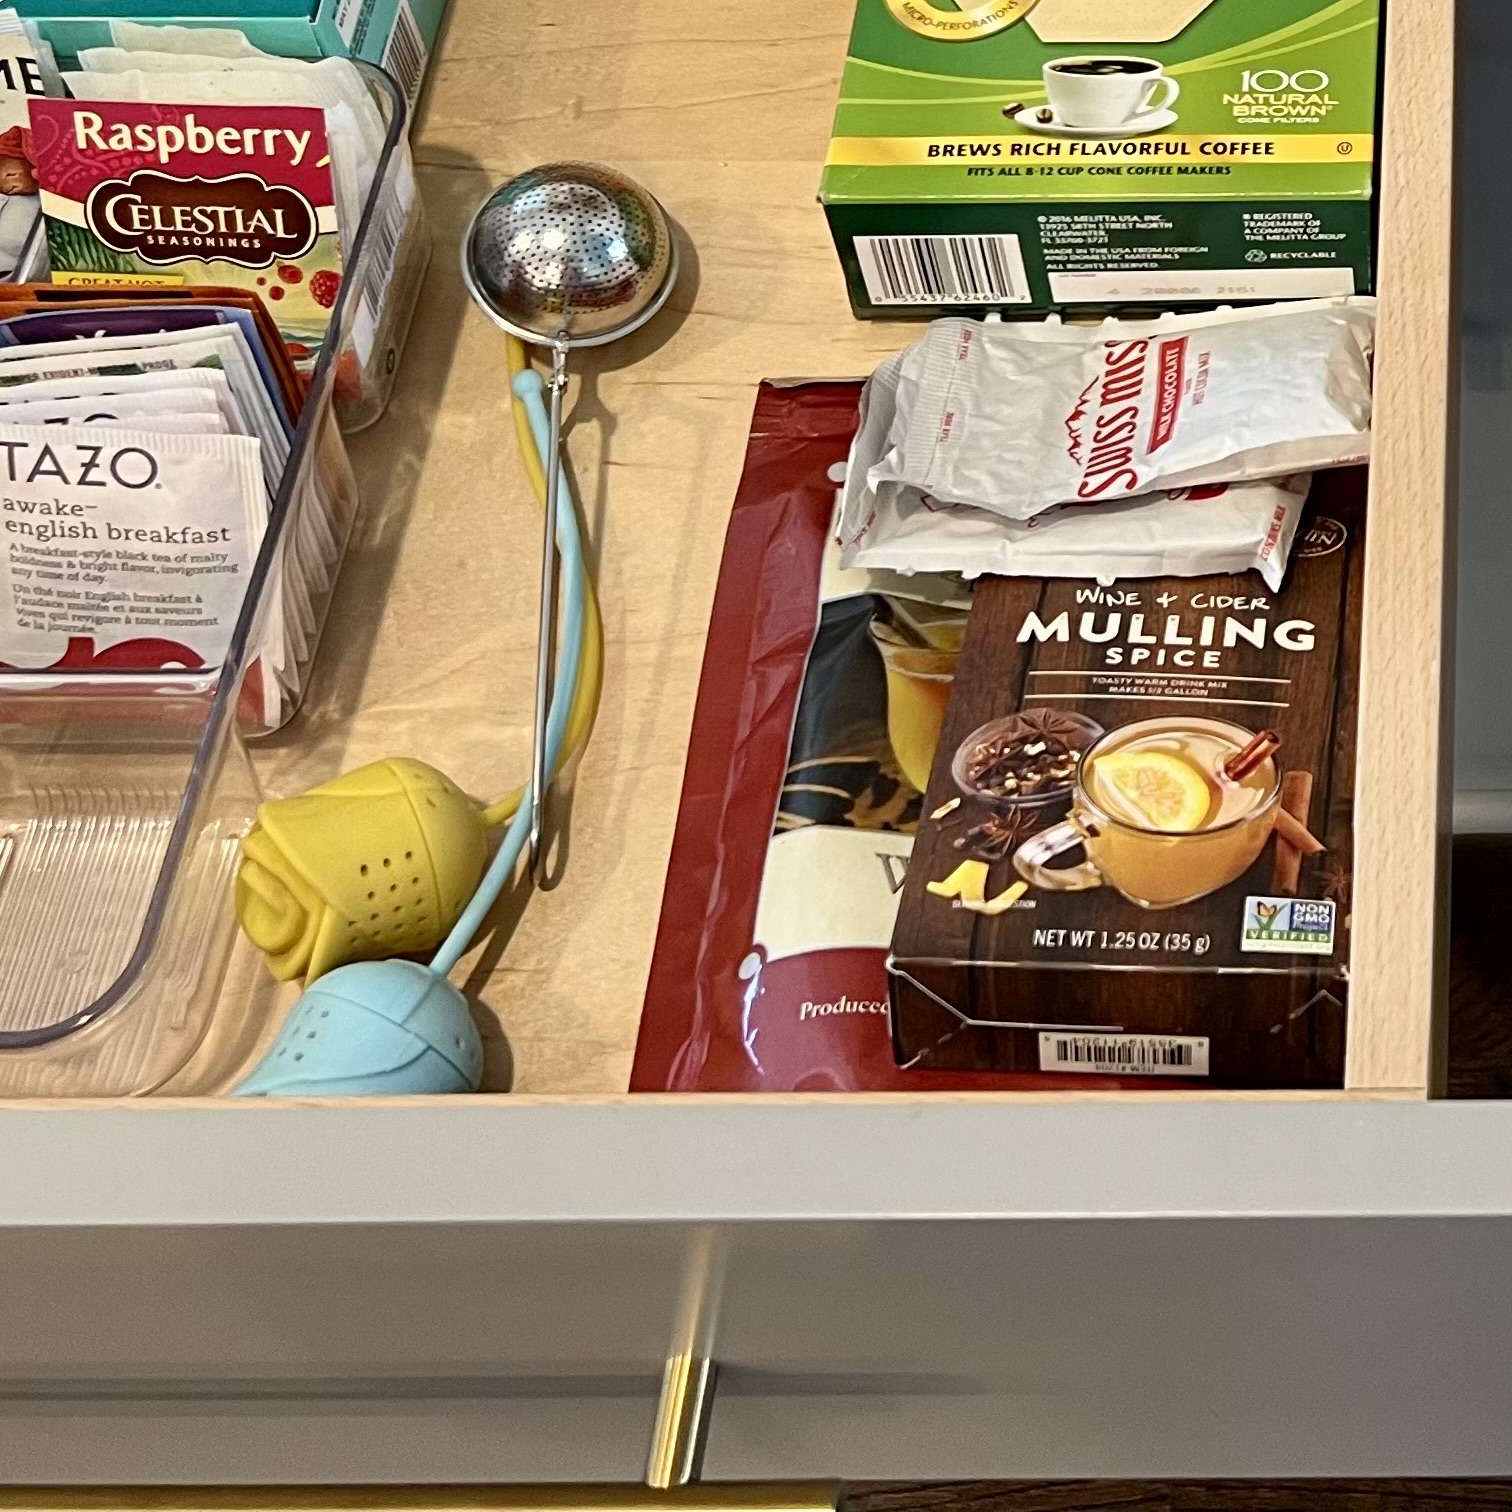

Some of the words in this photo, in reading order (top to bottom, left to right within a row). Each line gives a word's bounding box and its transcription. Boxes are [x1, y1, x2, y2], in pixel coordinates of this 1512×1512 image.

[902, 0, 1018, 31] MICRO-PERFORATIONS
[1240, 69, 1329, 93] 100
[1223, 93, 1339, 106] NATURAL
[1232, 104, 1329, 117] BROWN
[73, 111, 311, 165] Raspberry
[927, 143, 1002, 158] BREWS
[1010, 142, 1061, 157] RICH
[1069, 141, 1191, 156] FLAVORFUL
[1199, 141, 1275, 155] COFFEE
[967, 167, 994, 177] FITS
[998, 167, 1021, 177] ALL
[1058, 166, 1084, 176] CUP
[1087, 166, 1123, 176] CONE
[1126, 165, 1173, 176] COFFEE
[1176, 165, 1232, 175] MAKERS
[105, 194, 298, 239] CELESTIAL
[147, 235, 261, 248] SEASONINGS
[1078, 406, 1139, 498] SWISS
[0, 442, 158, 489] TAZO
[5, 519, 98, 542] english
[107, 523, 231, 544] breakfast
[116, 550, 148, 561] black
[152, 553, 171, 563] tea
[175, 552, 187, 563] of
[190, 552, 228, 565] malty
[11, 567, 32, 580] any
[36, 569, 63, 580] time
[67, 570, 79, 582] of
[79, 560, 118, 574] bright
[161, 564, 239, 577] invigorating
[85, 590, 130, 604] English
[133, 592, 192, 604] breakfast
[1076, 587, 1141, 607] WINE
[1156, 591, 1177, 606] +
[1191, 593, 1270, 610] CIDER
[1016, 611, 1315, 651] MULLING
[1105, 647, 1221, 668] SPICE
[1092, 677, 1132, 685] TOASTY
[1135, 678, 1168, 686] WARM
[1170, 679, 1205, 687] DRINK
[1165, 688, 1208, 696] GALLON
[1294, 903, 1330, 915] NON
[1293, 913, 1330, 923] GMO
[1032, 929, 1066, 948] NET
[1070, 930, 1096, 949] WT
[1100, 931, 1136, 950] 1.25
[1139, 932, 1161, 951] OZ
[1164, 933, 1192, 953] (35
[1250, 930, 1329, 942] VERIFIED
